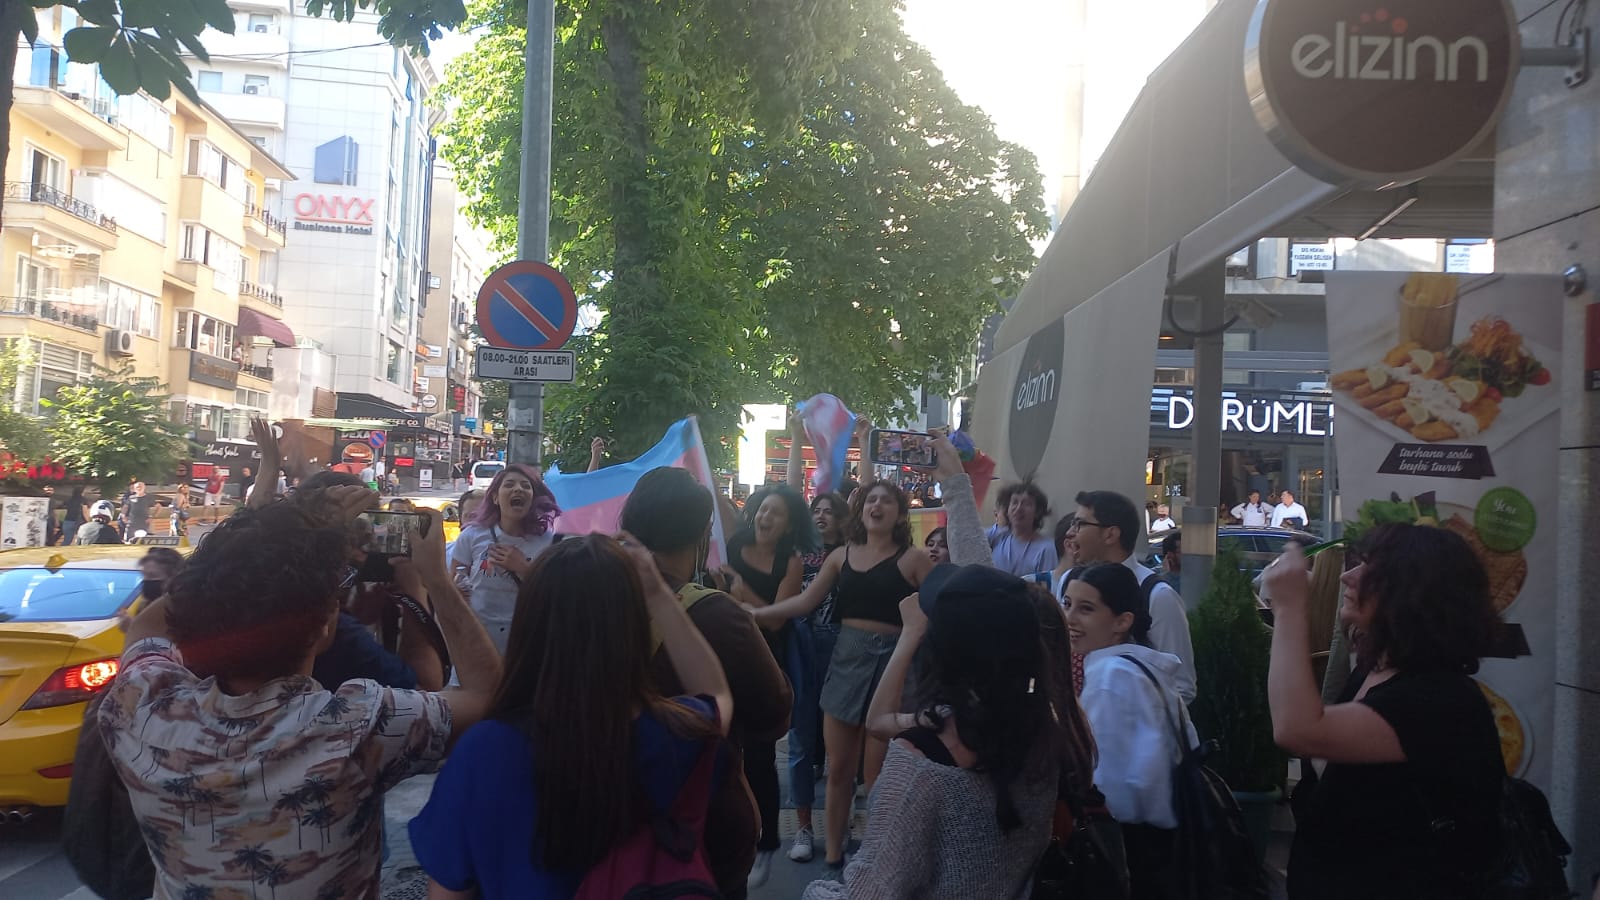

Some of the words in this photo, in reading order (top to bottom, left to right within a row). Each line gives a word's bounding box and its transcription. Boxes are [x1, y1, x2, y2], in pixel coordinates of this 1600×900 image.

[1291, 20, 1488, 82] elizinn
[294, 192, 375, 221] ONYX
[294, 222, 342, 233] Business
[346, 225, 373, 235] Hotel
[483, 352, 529, 365] 08.00-21.00
[513, 366, 538, 377] ARASI
[1016, 369, 1055, 411] elizinn
[1169, 396, 1334, 437] DRÜML
[1399, 447, 1444, 459] tarhana
[1446, 448, 1474, 459] soslu
[1399, 460, 1430, 474] beybi
[1431, 461, 1463, 472] tavuk
